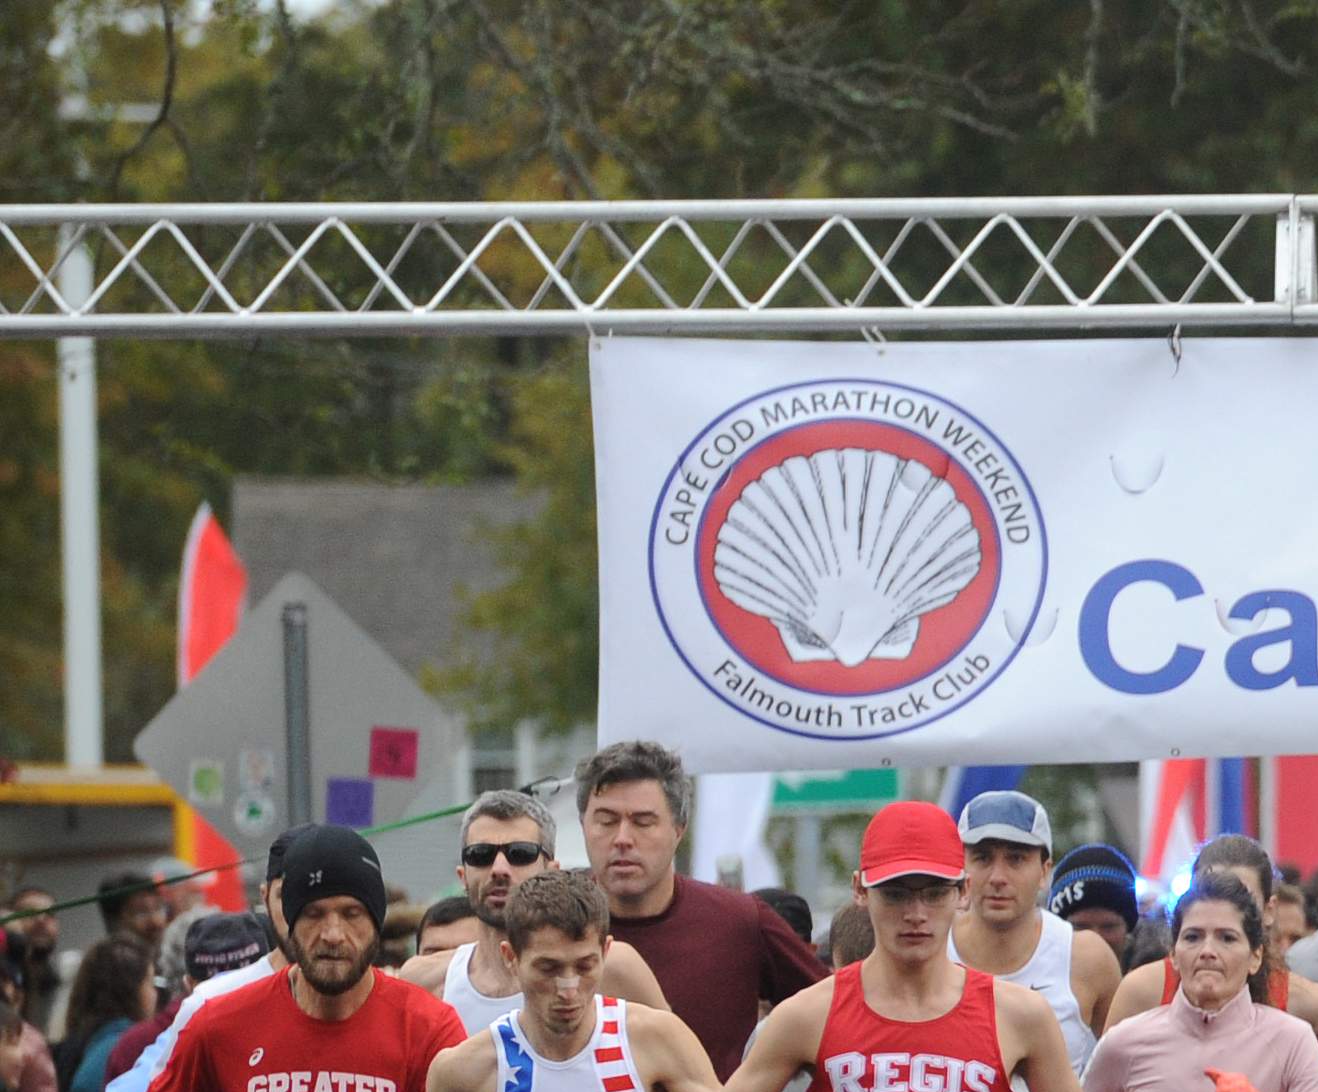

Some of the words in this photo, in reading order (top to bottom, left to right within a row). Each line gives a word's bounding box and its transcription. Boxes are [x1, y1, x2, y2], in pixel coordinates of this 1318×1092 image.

[665, 470, 709, 546] CAPE
[699, 418, 755, 472] COD
[760, 389, 942, 430] MARATHON
[941, 422, 1031, 546] WEEKEND
[713, 657, 843, 729] Falmouth
[853, 692, 929, 728] Track
[931, 651, 990, 702] Club
